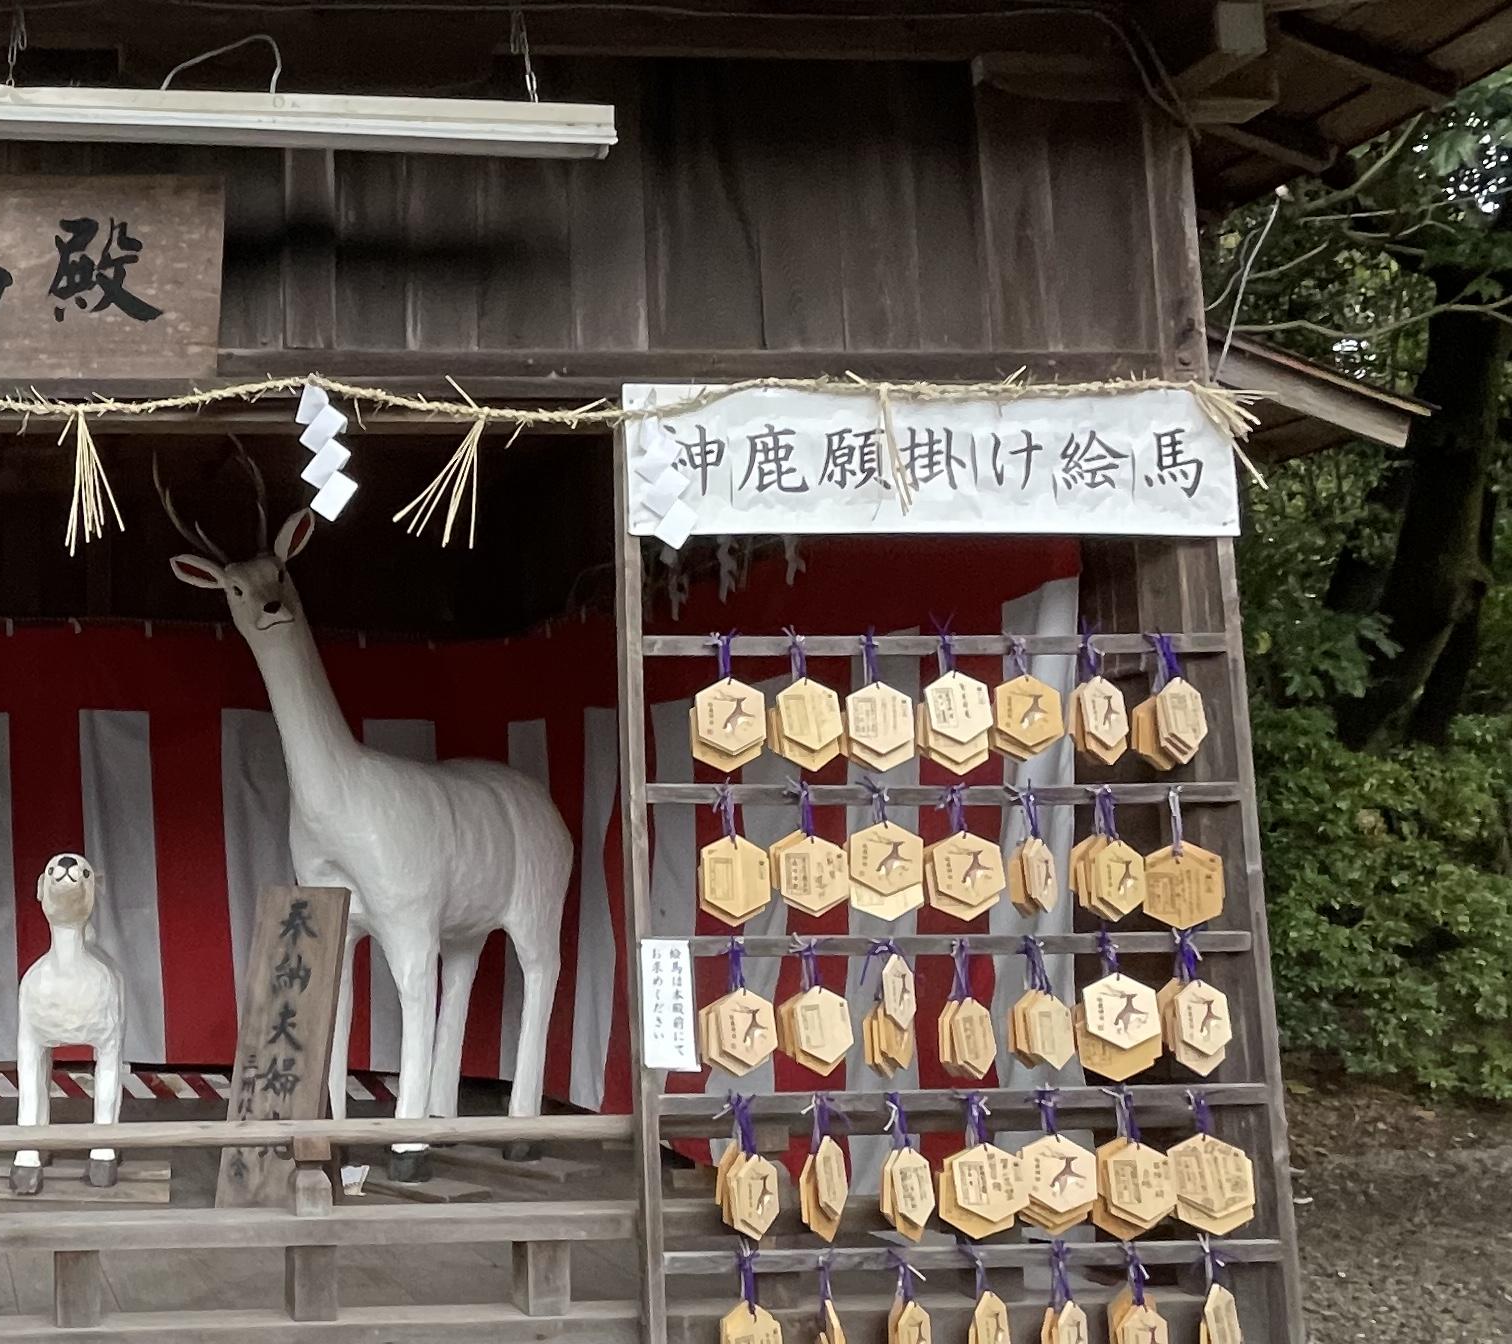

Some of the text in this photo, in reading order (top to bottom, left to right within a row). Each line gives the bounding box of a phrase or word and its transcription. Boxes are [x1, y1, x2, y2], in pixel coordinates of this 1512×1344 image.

[651, 947, 665, 1041] お求めください
[669, 947, 685, 1057] 絵馬は本殿前にて
